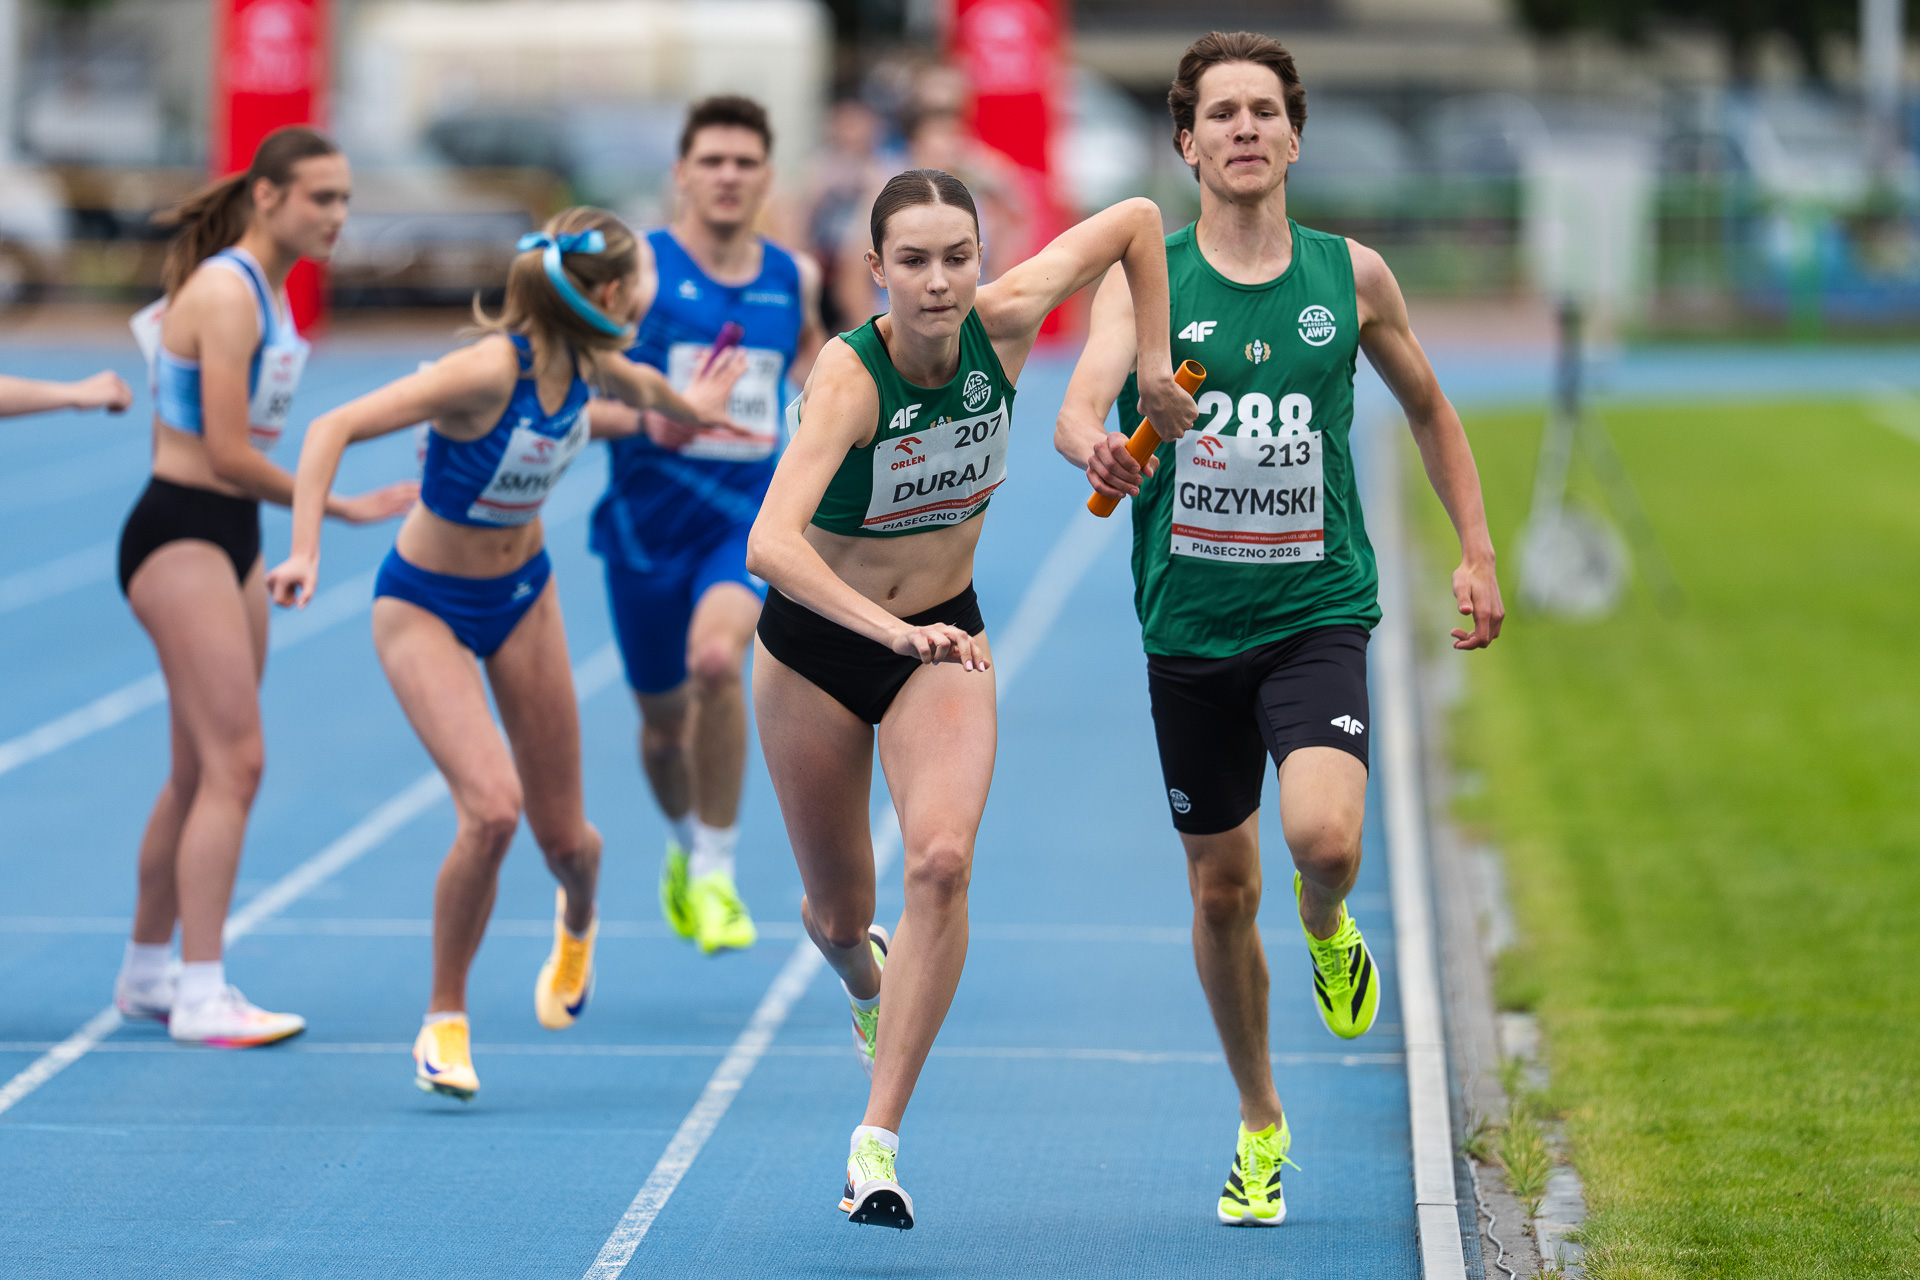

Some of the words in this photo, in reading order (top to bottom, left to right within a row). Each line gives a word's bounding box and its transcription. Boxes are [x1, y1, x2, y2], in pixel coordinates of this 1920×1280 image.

[1306, 311, 1328, 322] AZS
[1177, 320, 1218, 343] 4F
[1306, 327, 1331, 338] AWF
[968, 375, 983, 391] AZS
[969, 389, 987, 407] AWF
[888, 403, 923, 430] 4F
[1197, 390, 1313, 438] 288
[954, 411, 1003, 449] 207
[890, 454, 926, 471] ORLEN
[1192, 456, 1227, 471] ORLEN
[1257, 440, 1311, 468] 213
[892, 454, 991, 504] DURAJ
[1179, 481, 1316, 516] GRZYMSKI
[882, 512, 958, 532] PIASECZNO
[1192, 542, 1267, 559] PIASECZNO
[1269, 546, 1301, 559] 2026
[1330, 714, 1365, 736] 4F
